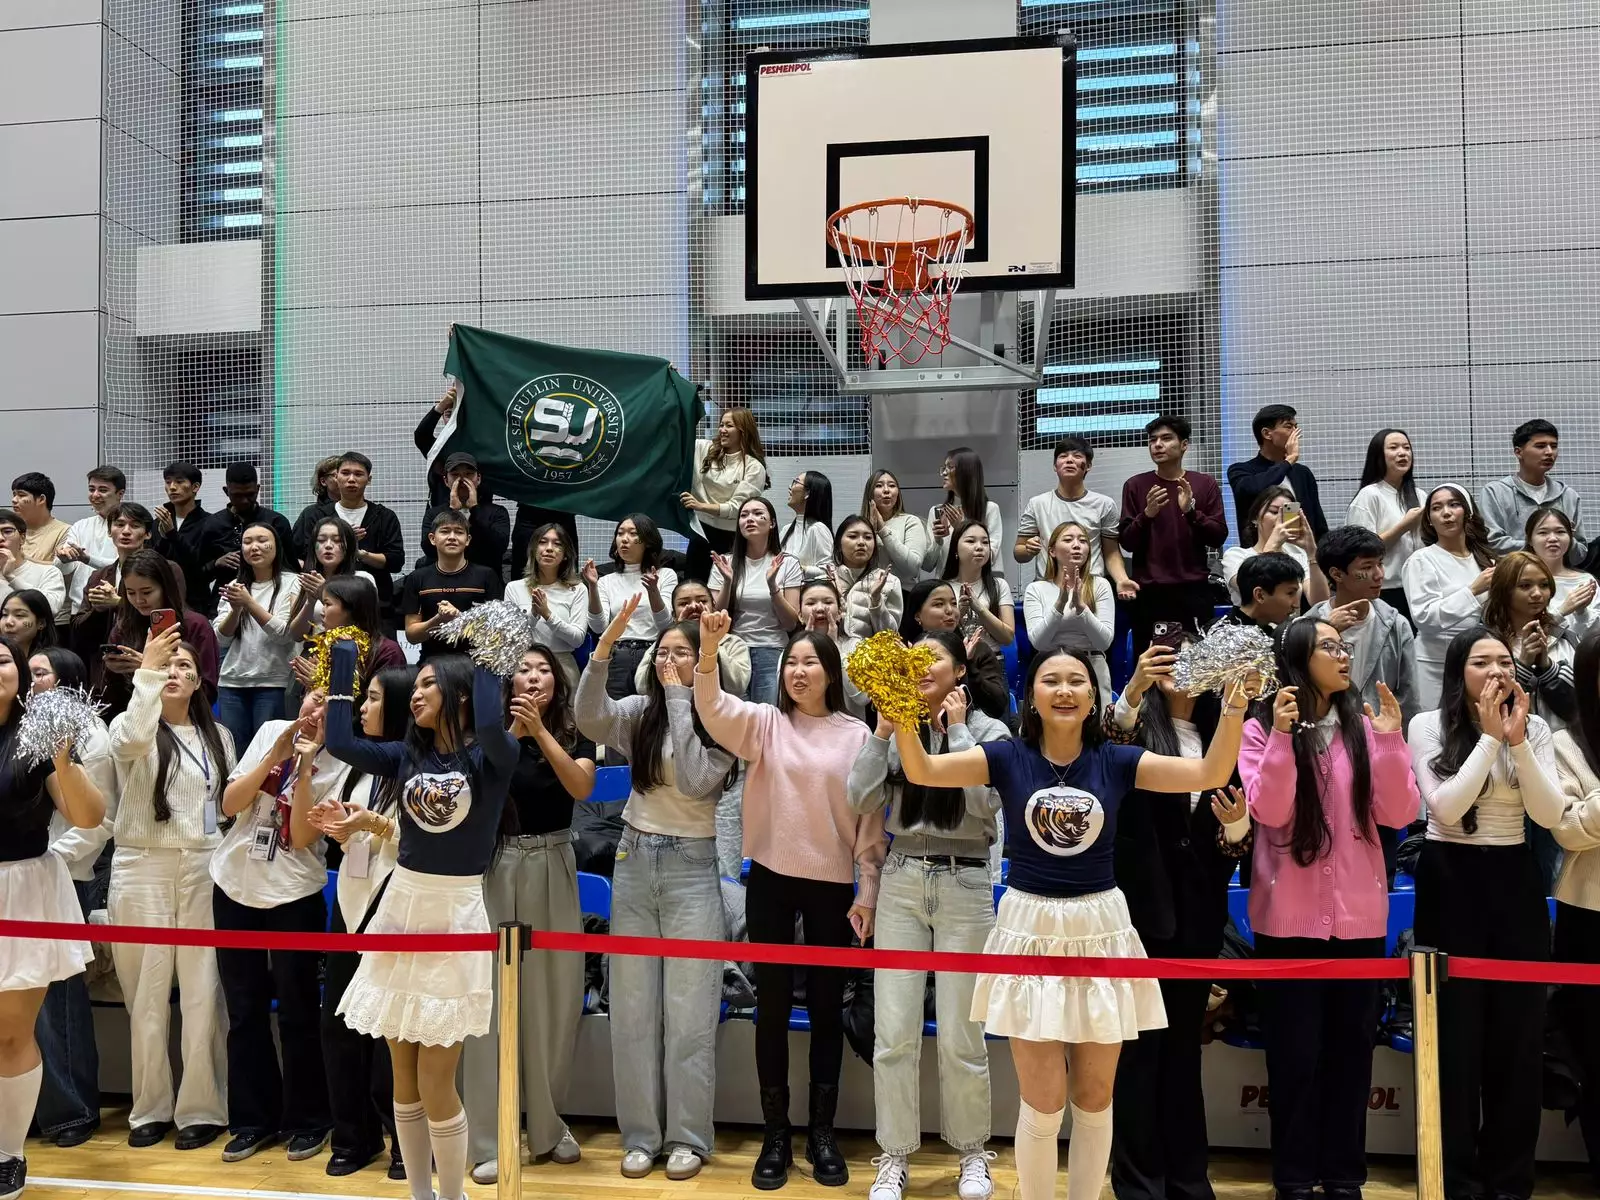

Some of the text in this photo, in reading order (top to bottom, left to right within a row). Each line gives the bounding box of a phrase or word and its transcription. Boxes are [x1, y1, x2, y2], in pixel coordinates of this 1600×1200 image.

[511, 378, 619, 448] SEIFULLIN UNIVERSITY
[530, 397, 599, 446] SU
[543, 469, 572, 480] 1957
[185, 672, 196, 682] SU
